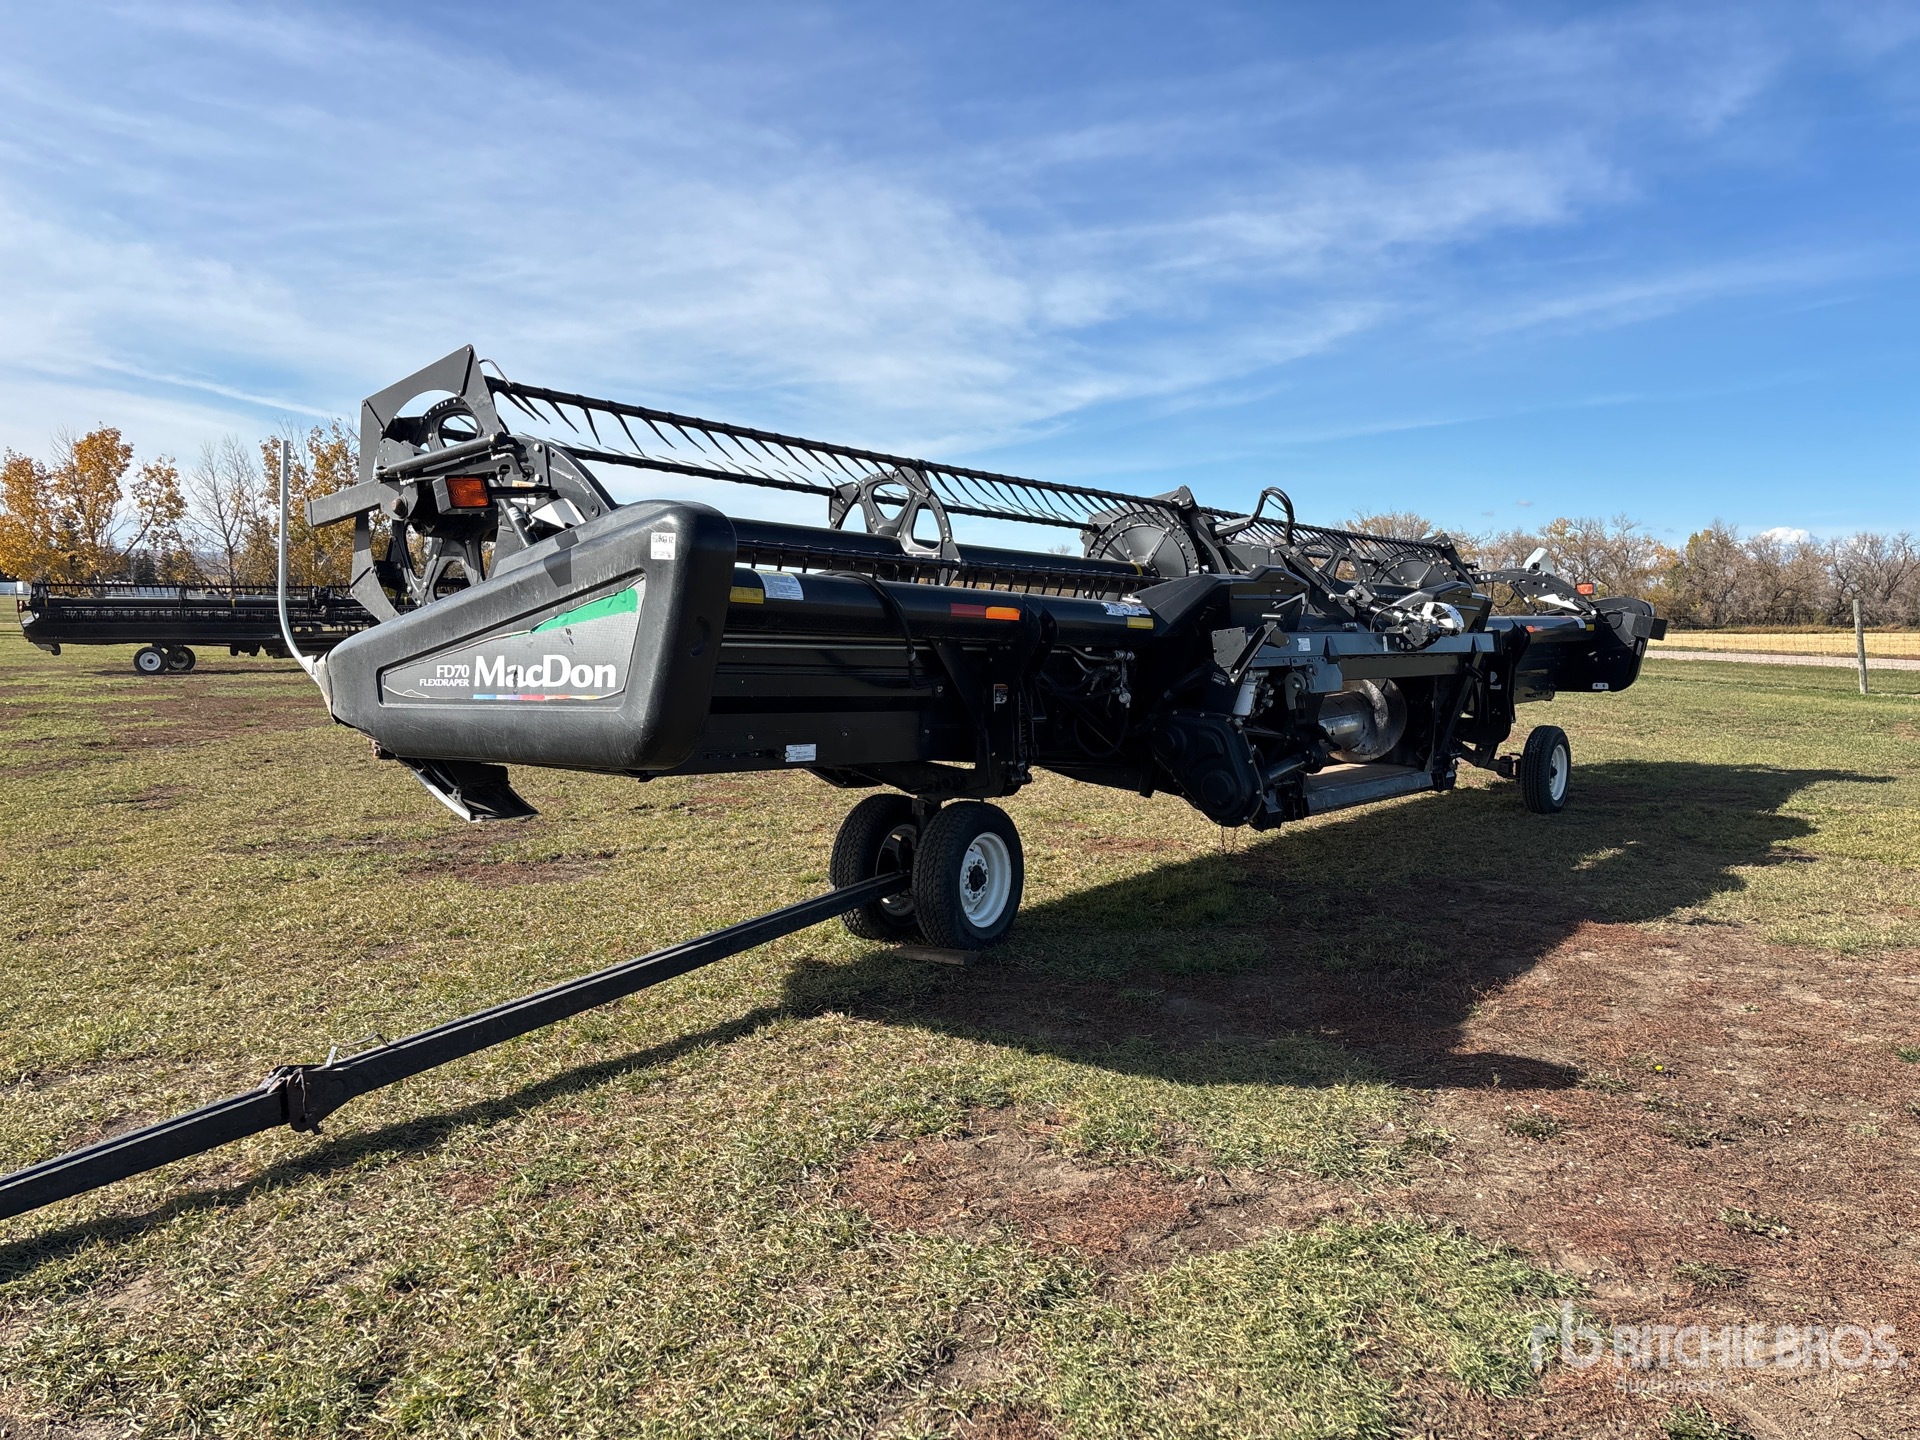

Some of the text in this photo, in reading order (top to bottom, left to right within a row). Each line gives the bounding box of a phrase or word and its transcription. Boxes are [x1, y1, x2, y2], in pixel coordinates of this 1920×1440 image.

[436, 665, 470, 678] FD70
[475, 654, 616, 687] MacDon
[419, 678, 470, 687] FLEXDRAPER
